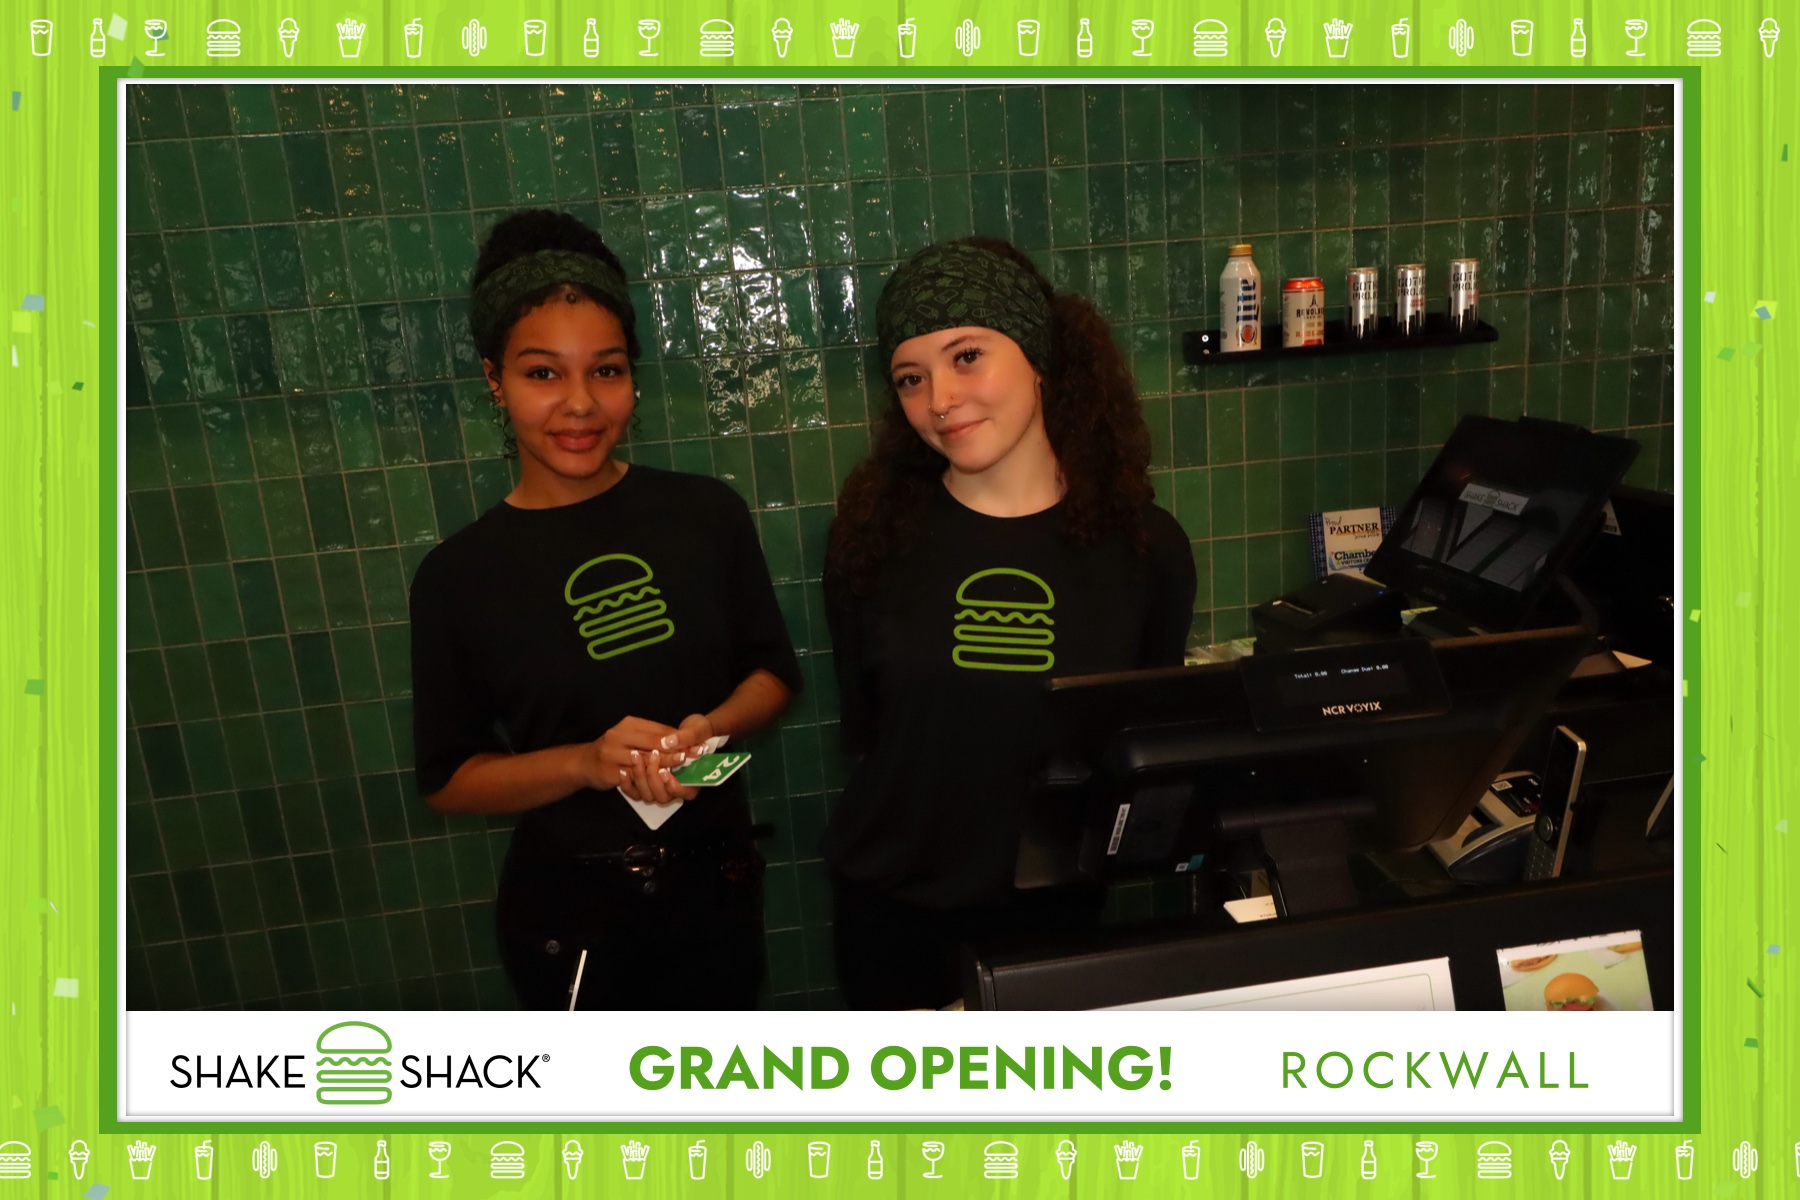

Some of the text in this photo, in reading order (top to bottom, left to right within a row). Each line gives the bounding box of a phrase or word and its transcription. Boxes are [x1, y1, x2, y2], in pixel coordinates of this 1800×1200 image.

[1464, 491, 1519, 511] SHAKE SHACK
[1329, 522, 1379, 535] PARTNER
[1322, 701, 1382, 716] NCR VOYIX
[702, 756, 740, 782] 24
